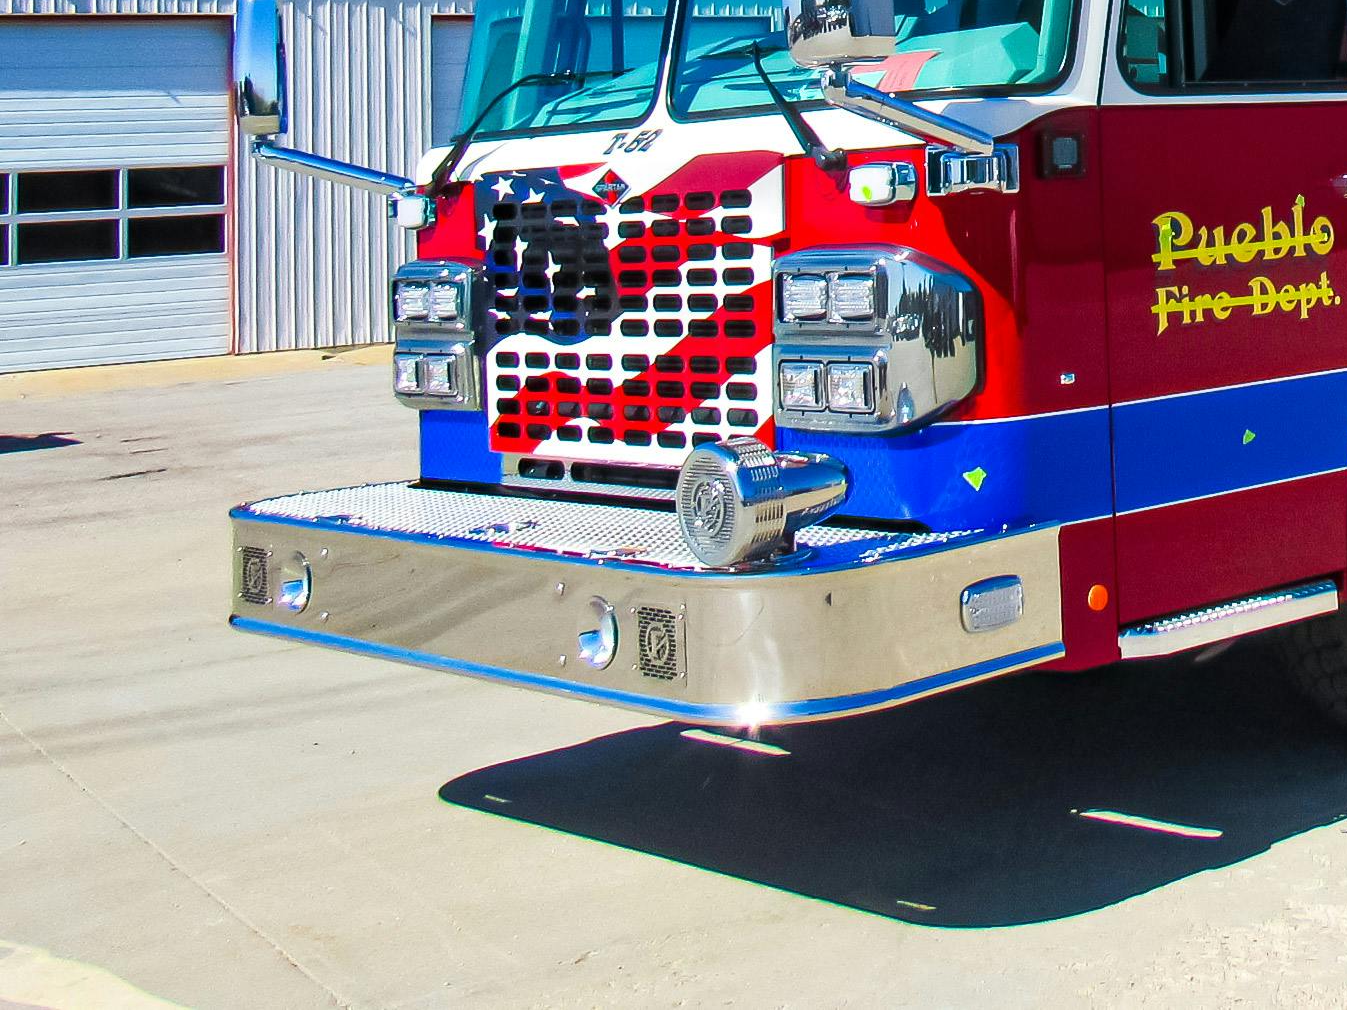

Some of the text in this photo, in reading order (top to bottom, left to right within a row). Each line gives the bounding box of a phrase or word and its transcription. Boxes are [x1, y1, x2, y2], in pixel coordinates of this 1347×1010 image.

[603, 129, 663, 155] T-52
[1152, 205, 1334, 270] Pueblo
[1154, 271, 1341, 335] Fire Dept.
